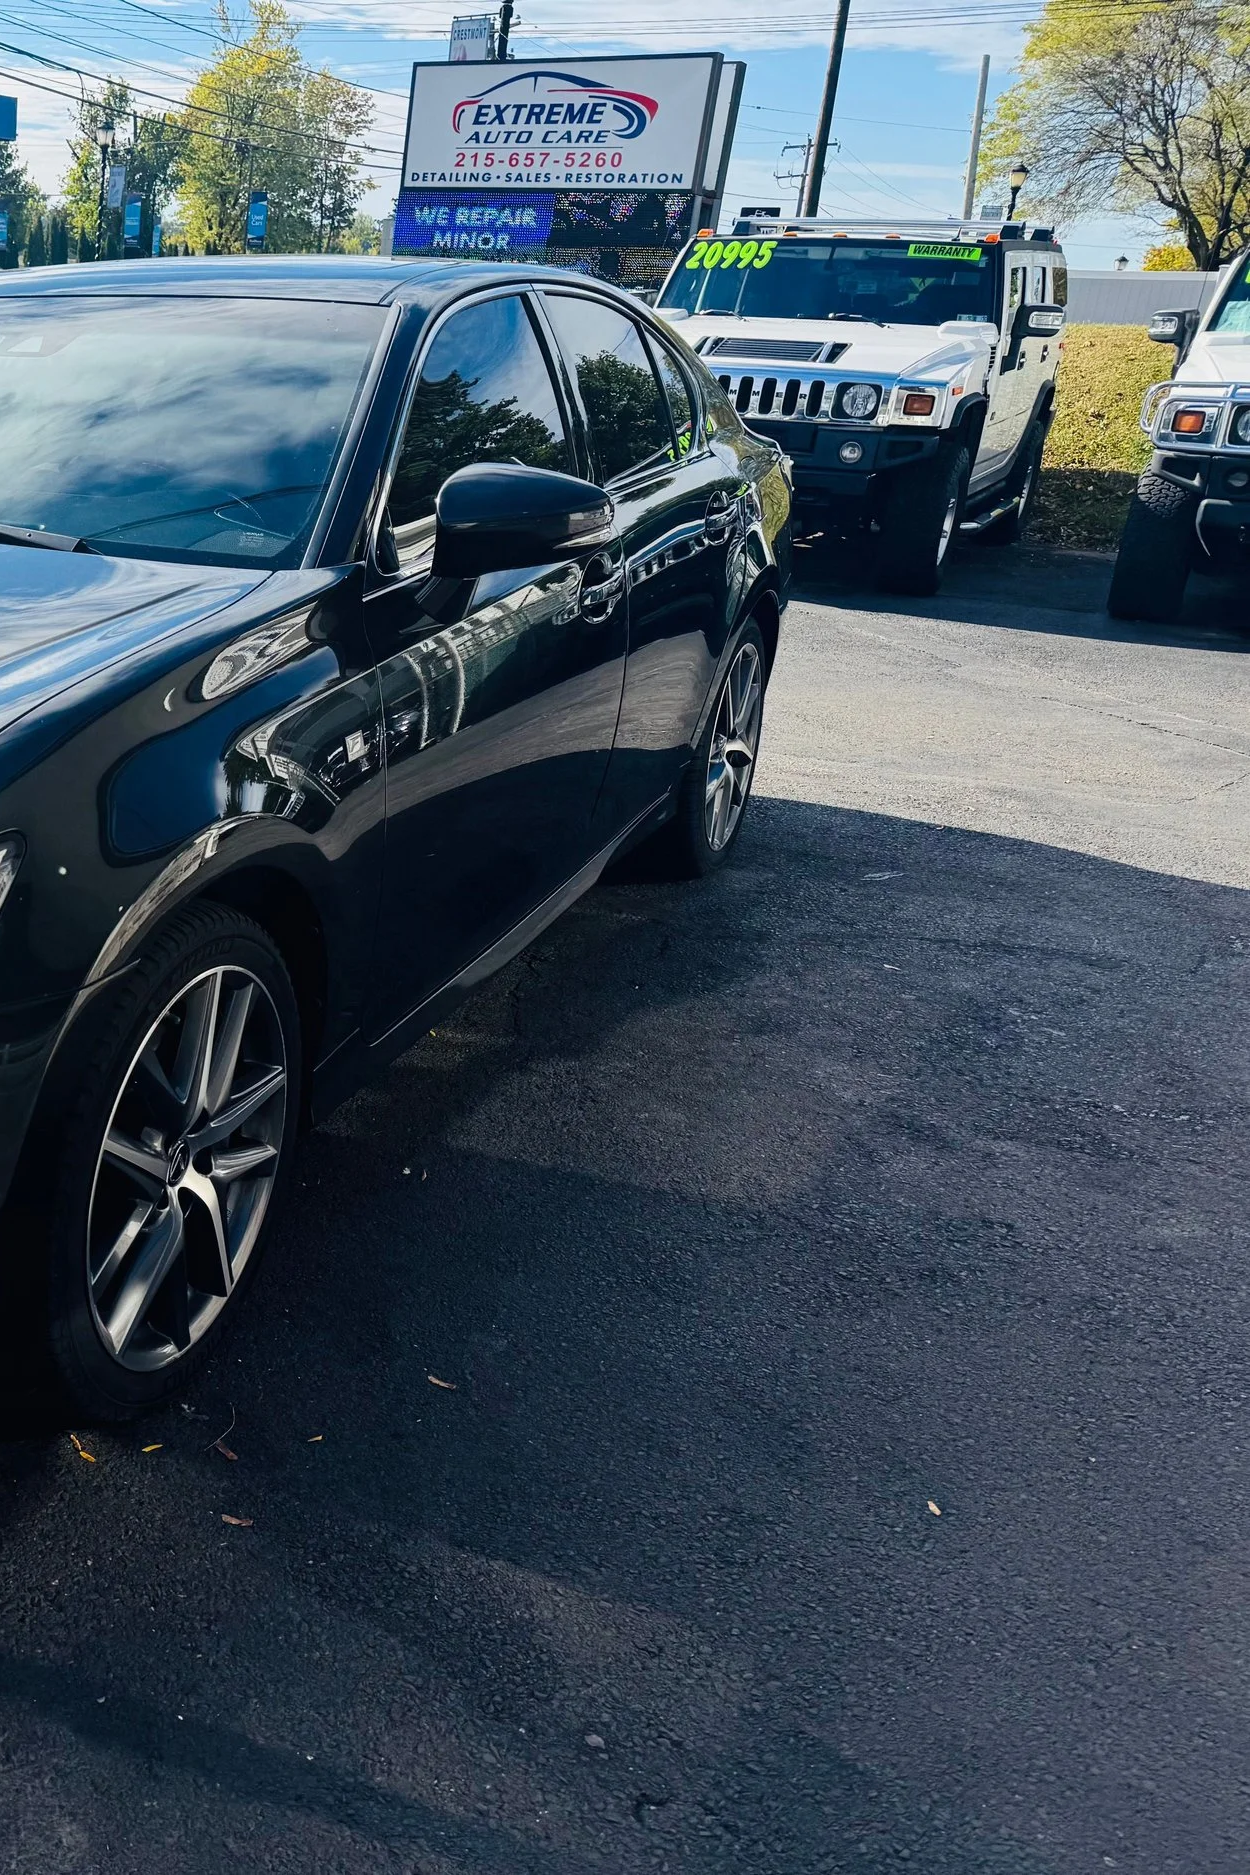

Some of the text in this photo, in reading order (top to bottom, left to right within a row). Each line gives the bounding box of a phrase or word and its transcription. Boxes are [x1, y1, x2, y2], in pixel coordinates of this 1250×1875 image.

[453, 27, 487, 41] CRESTMONT
[471, 102, 607, 126] EXTREME
[464, 130, 610, 144] AUTO CARE
[454, 152, 624, 168] 215-657-5260
[411, 172, 684, 184] DETAILING SALES RESTORATION
[414, 205, 538, 229] WE REPAIR
[432, 231, 511, 250] MINOR
[685, 240, 778, 270] 20995
[912, 244, 976, 259] WARRANTY
